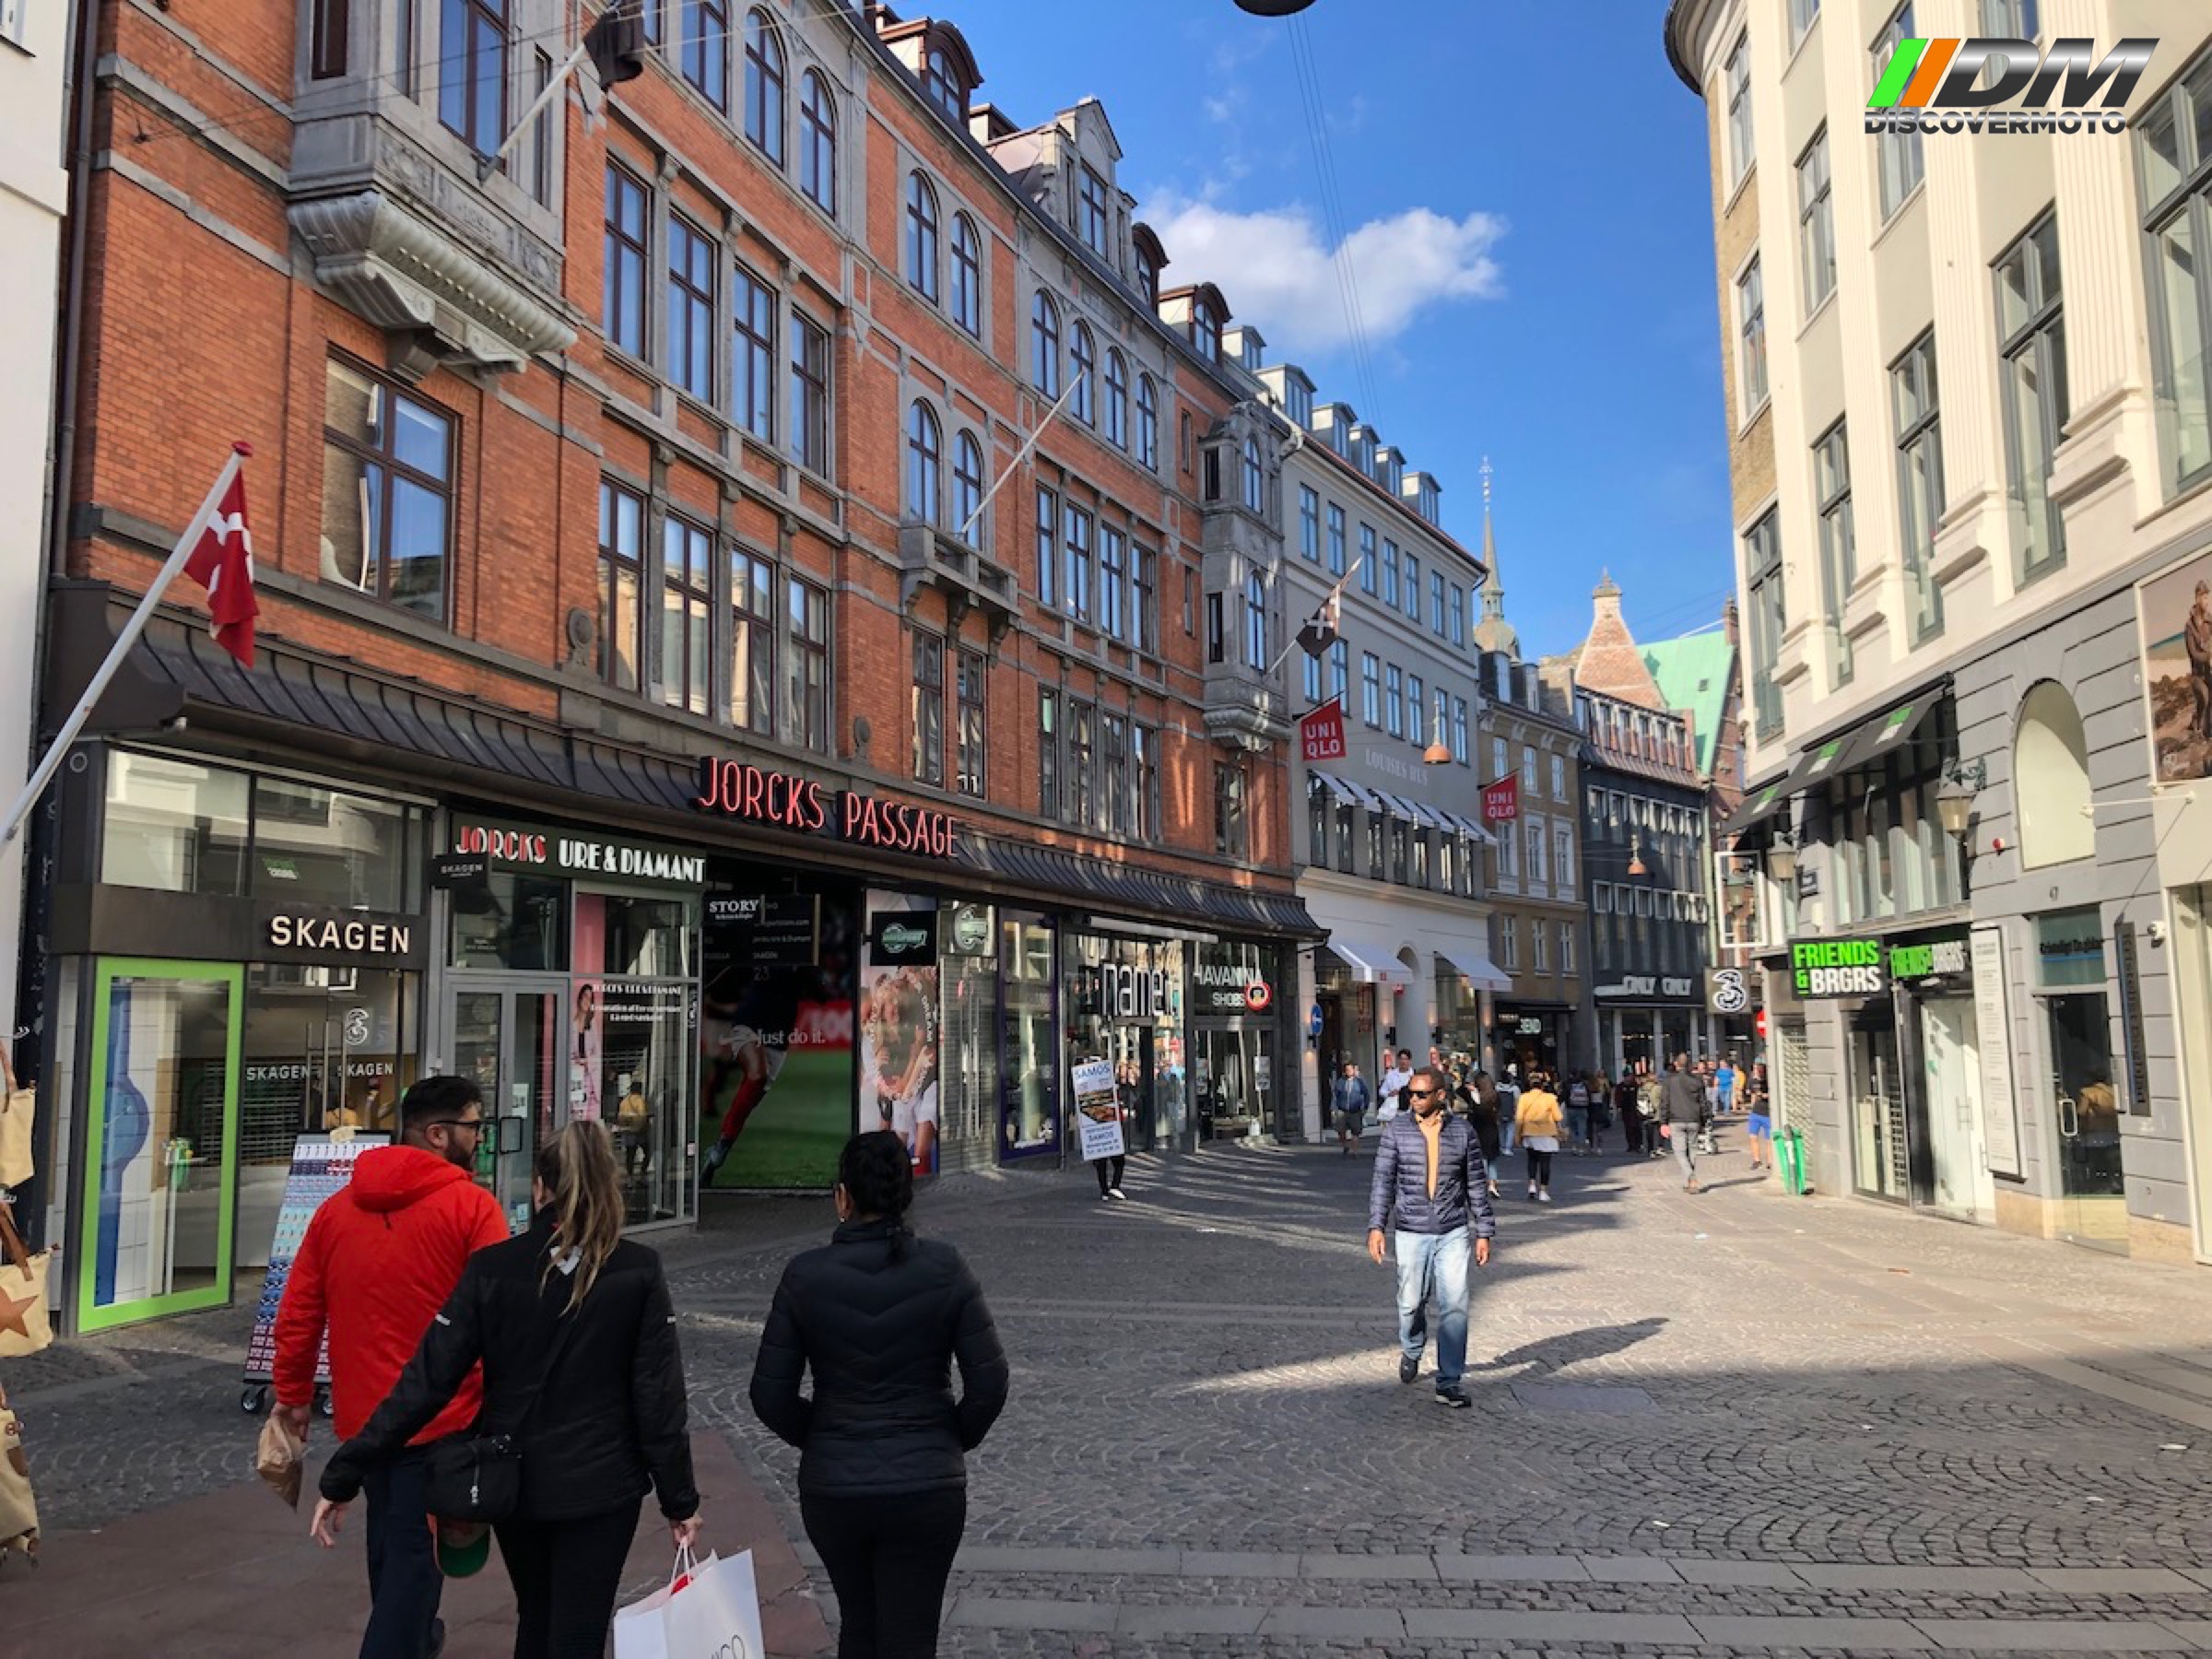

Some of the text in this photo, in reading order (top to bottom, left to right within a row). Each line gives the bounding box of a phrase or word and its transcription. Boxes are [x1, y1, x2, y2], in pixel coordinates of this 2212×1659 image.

[1306, 722, 1336, 739] UNI
[1307, 739, 1340, 759] QLO
[697, 756, 959, 857] JORCKS PASSAGE
[1487, 792, 1512, 805] UNI
[1488, 805, 1514, 818] QLO
[455, 826, 547, 864] JORCKS
[441, 863, 484, 876] SKAGEN
[710, 900, 760, 912] STORY
[270, 915, 410, 955] SKAGEN
[1793, 939, 1881, 969] FRIENDS
[1810, 966, 1882, 994] BRGRS
[1712, 969, 1746, 1012] 3
[756, 1028, 827, 1047] Just do it.
[246, 1065, 311, 1081] SKAGEN
[1074, 1063, 1111, 1078] SAMOS
